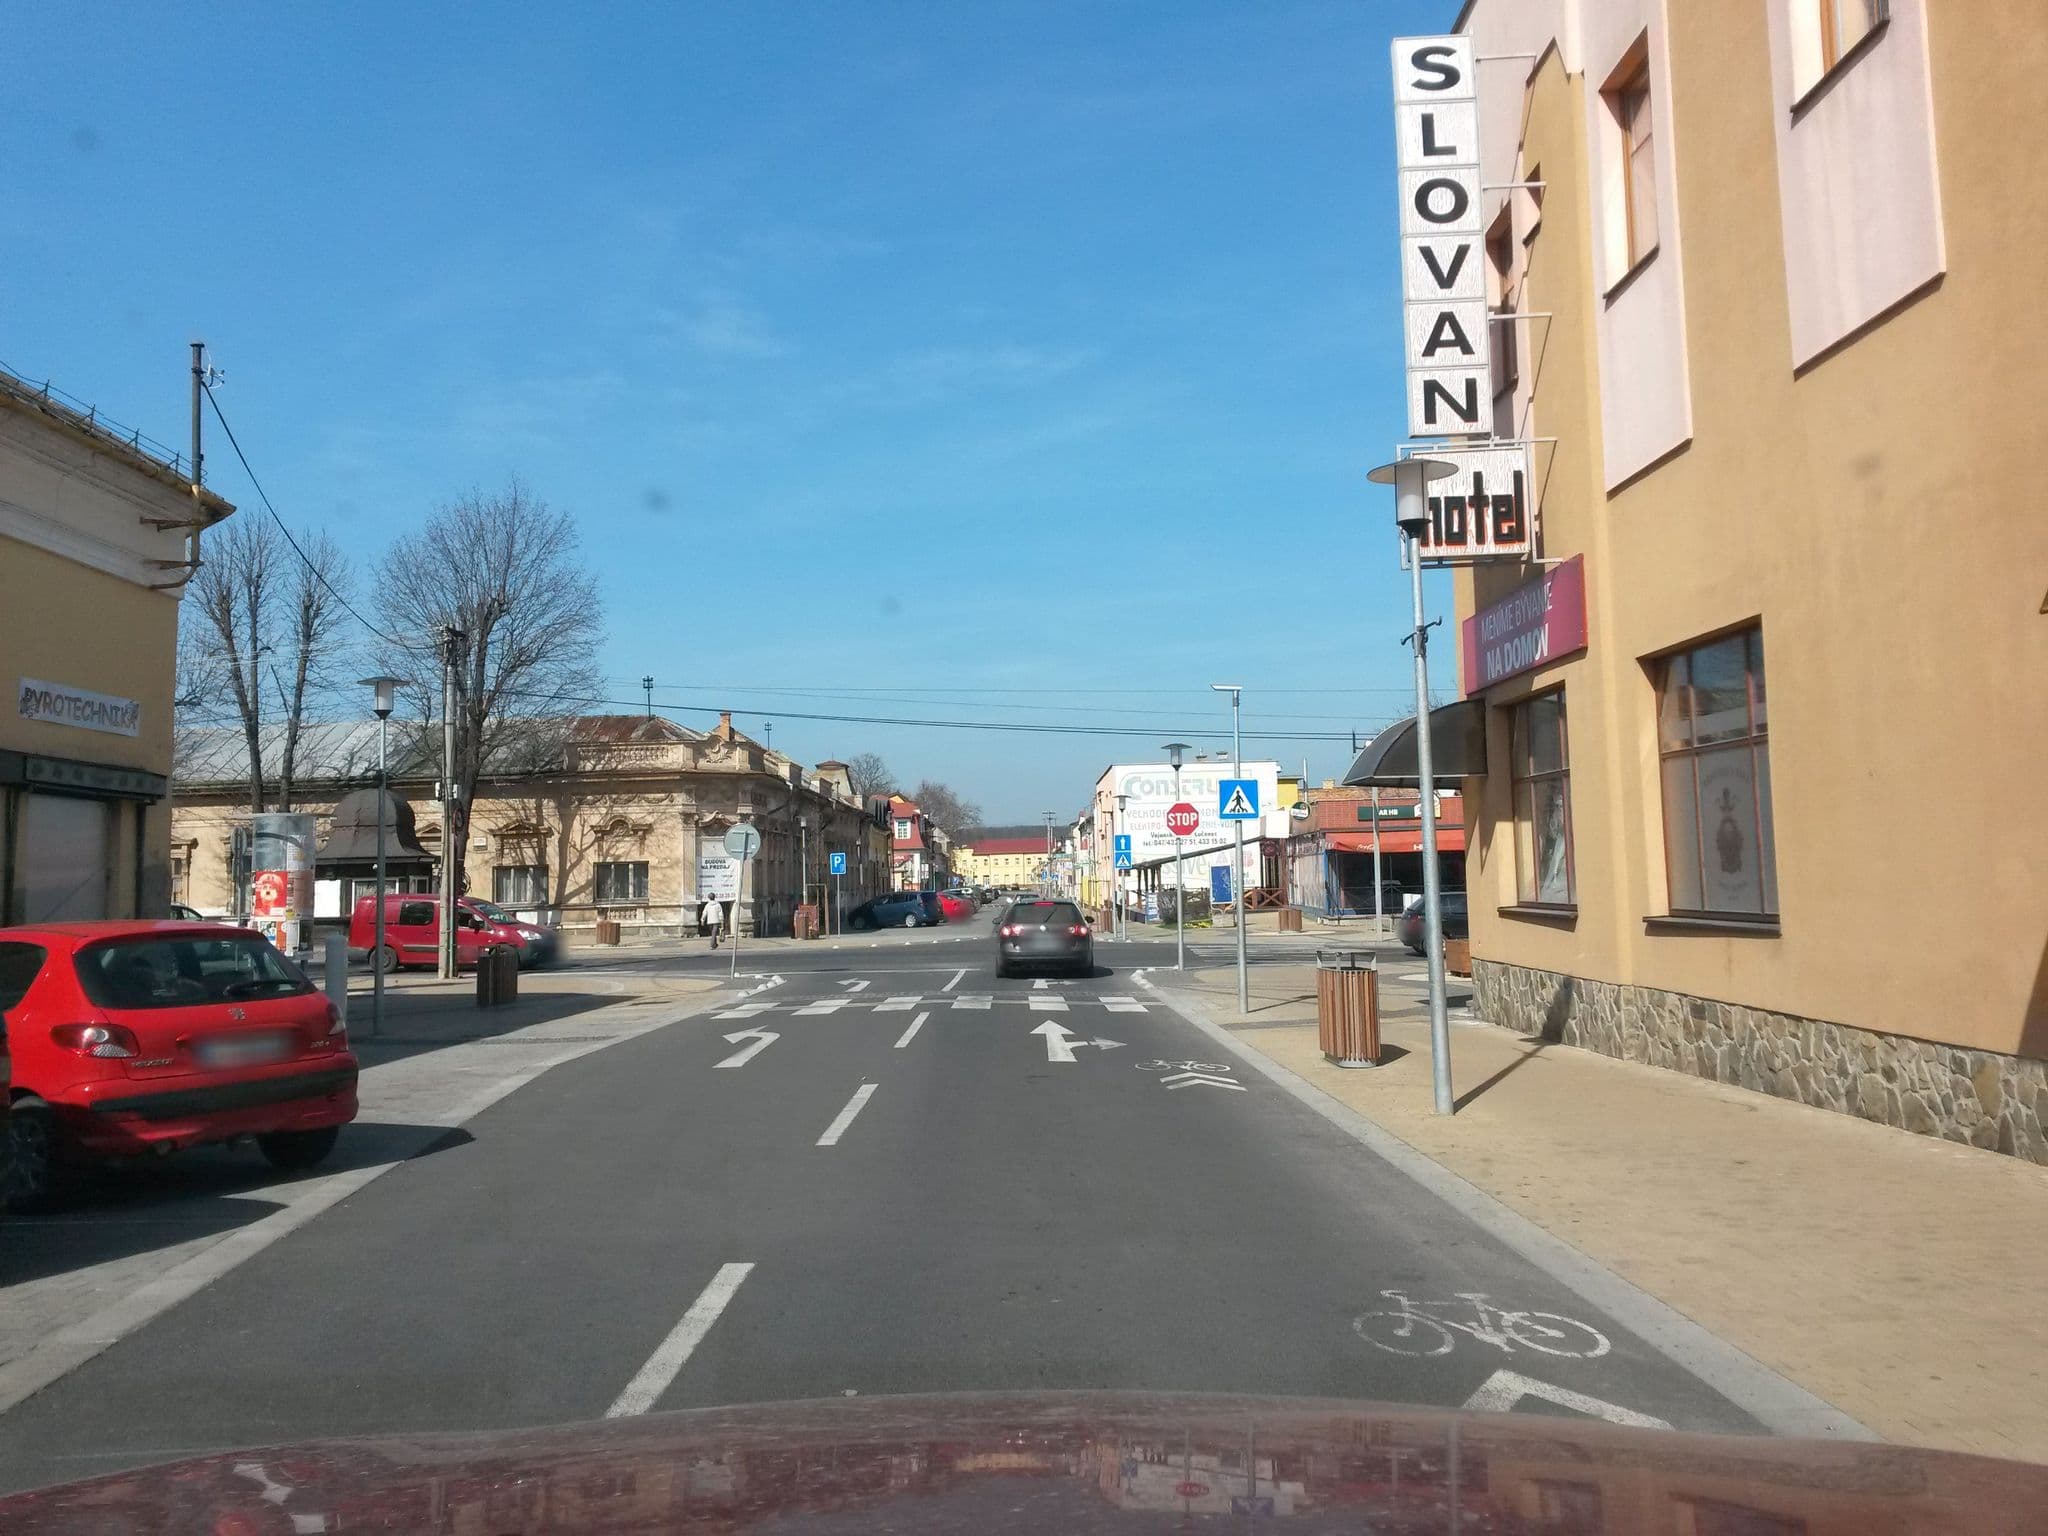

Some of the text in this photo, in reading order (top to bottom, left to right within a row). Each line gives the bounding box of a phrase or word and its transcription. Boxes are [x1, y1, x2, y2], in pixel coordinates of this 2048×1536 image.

[1411, 45, 1479, 425] SLOVAN
[1486, 622, 1549, 680] NA DOMOV
[1168, 811, 1199, 827] STOP
[834, 855, 842, 867] P
